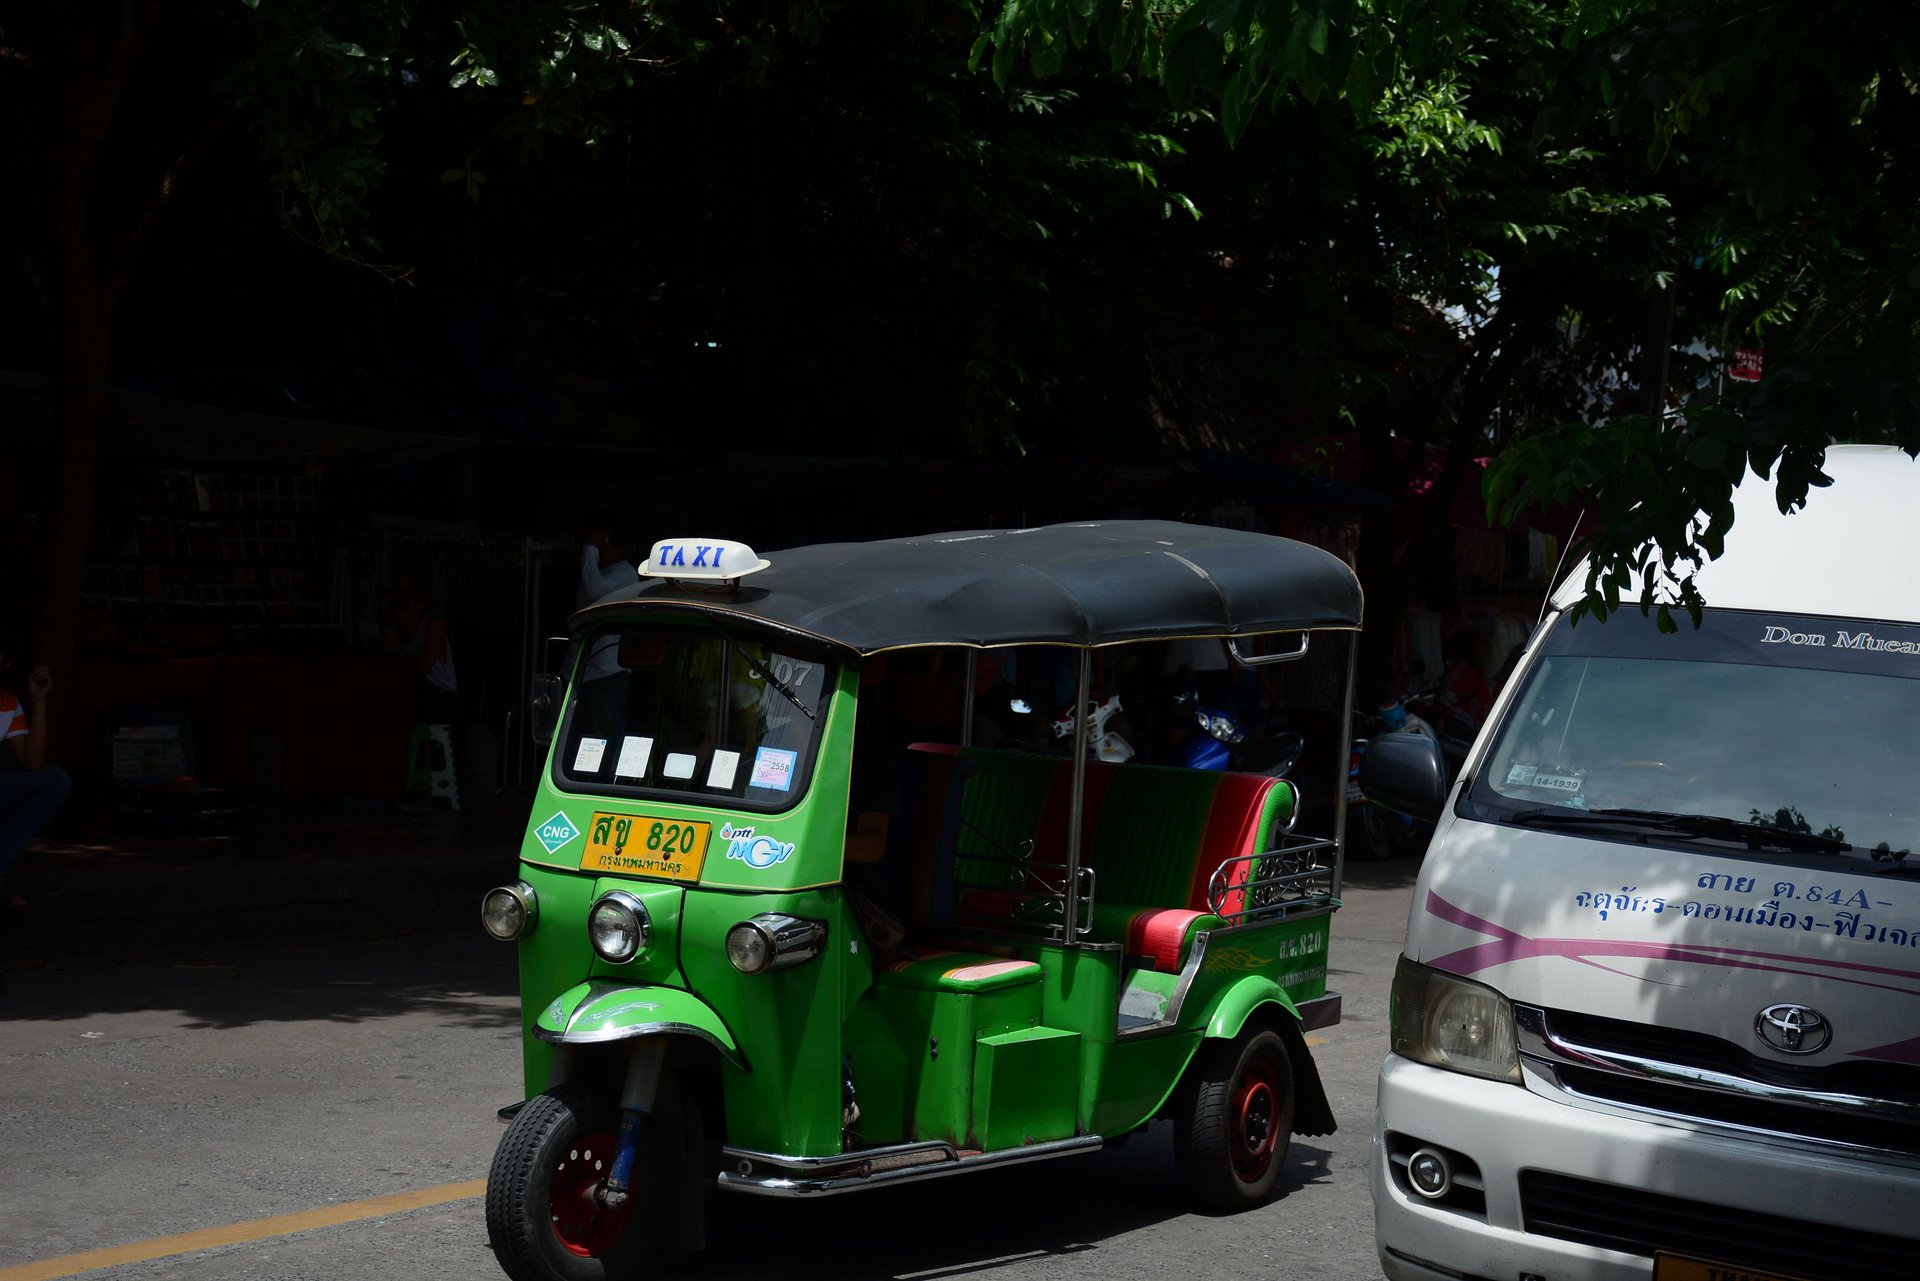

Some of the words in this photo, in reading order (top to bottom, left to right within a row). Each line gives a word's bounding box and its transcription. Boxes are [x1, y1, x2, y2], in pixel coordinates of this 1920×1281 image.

[659, 545, 725, 568] TAXI
[1761, 626, 1826, 647] Don
[1832, 631, 1920, 655] Muea
[770, 761, 790, 773] 2558
[1536, 777, 1579, 790] 14-1939
[543, 825, 570, 839] CNG
[593, 815, 633, 848] สข
[647, 822, 696, 854] 820
[731, 829, 752, 839] ptt
[728, 838, 794, 867] NGV
[599, 855, 683, 875] กรุงเทพมหานคร
[1697, 872, 1756, 894] สาย
[1300, 931, 1321, 956] 820
